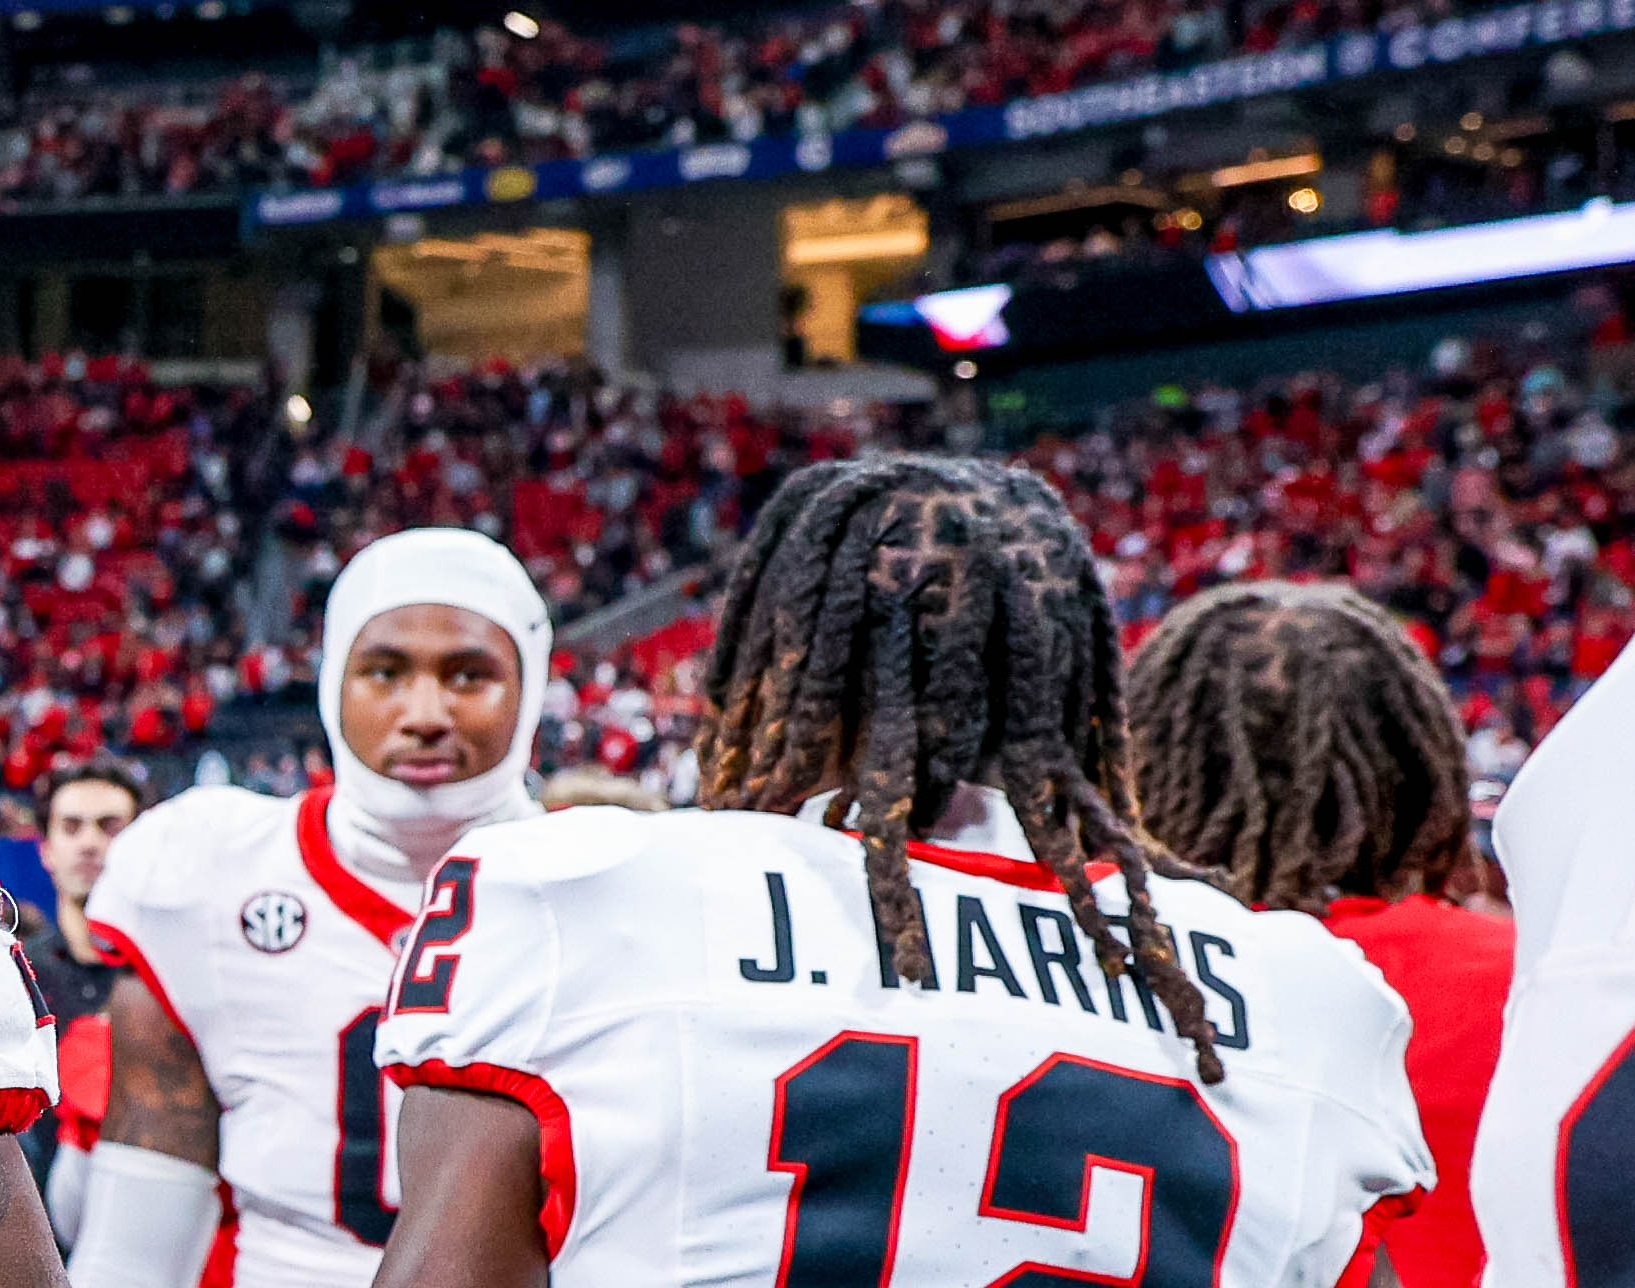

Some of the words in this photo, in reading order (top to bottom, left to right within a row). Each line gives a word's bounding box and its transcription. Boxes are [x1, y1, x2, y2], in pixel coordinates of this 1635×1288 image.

[242, 894, 306, 949] SEC
[739, 872, 827, 984] J.
[871, 888, 1250, 1050] HARRS
